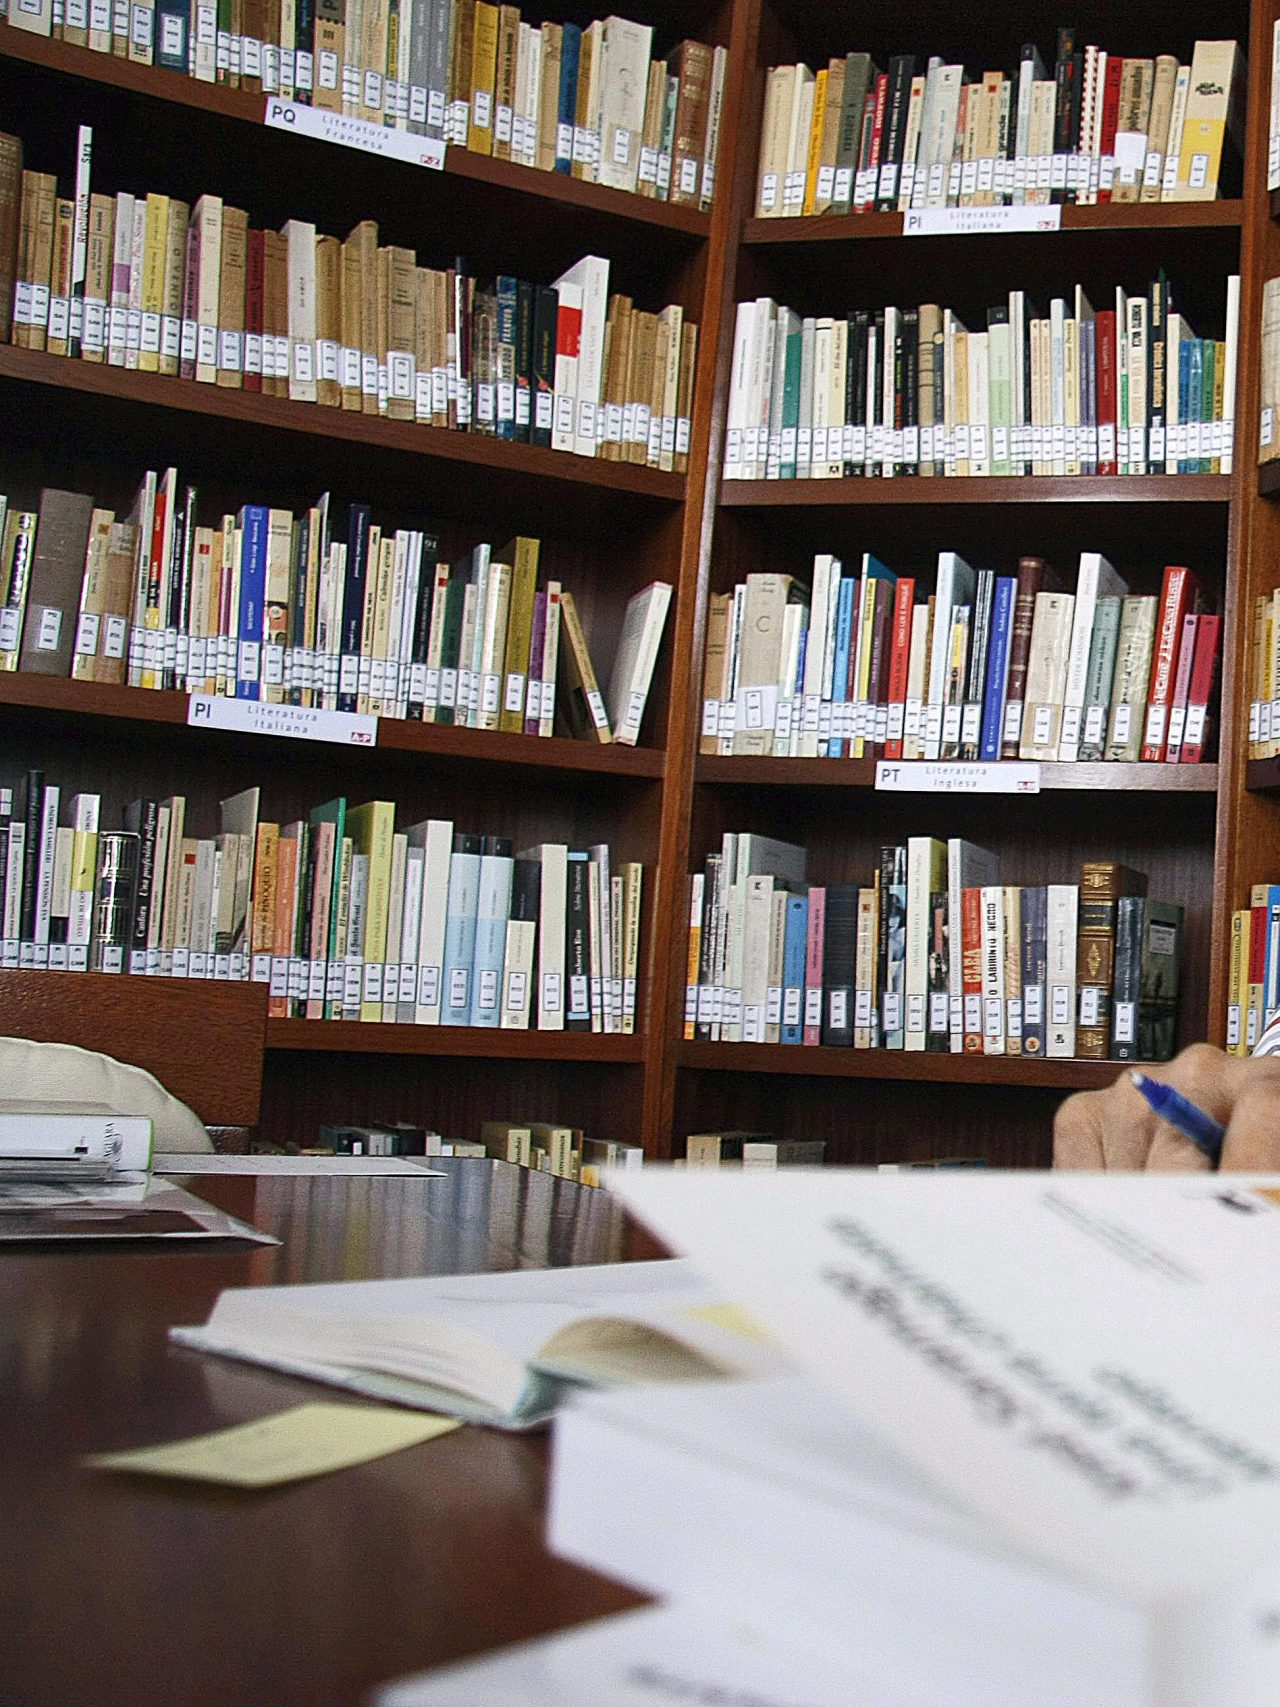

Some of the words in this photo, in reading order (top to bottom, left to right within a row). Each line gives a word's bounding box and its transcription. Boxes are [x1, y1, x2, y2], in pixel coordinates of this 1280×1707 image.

[272, 105, 297, 124] PQ
[322, 115, 389, 140] Literatura
[326, 129, 383, 150] Francesa
[909, 216, 921, 229] PI
[950, 211, 1009, 219] Literatura
[195, 703, 211, 718] PI
[247, 705, 318, 721] Literatura
[254, 720, 308, 733] Italiana
[881, 768, 900, 782] PT
[925, 766, 988, 776] Literatura
[934, 778, 977, 788] Inglesa
[136, 906, 147, 938] Canfora
[987, 902, 996, 936] NEGRO
[988, 938, 997, 983] LABIRINTO
